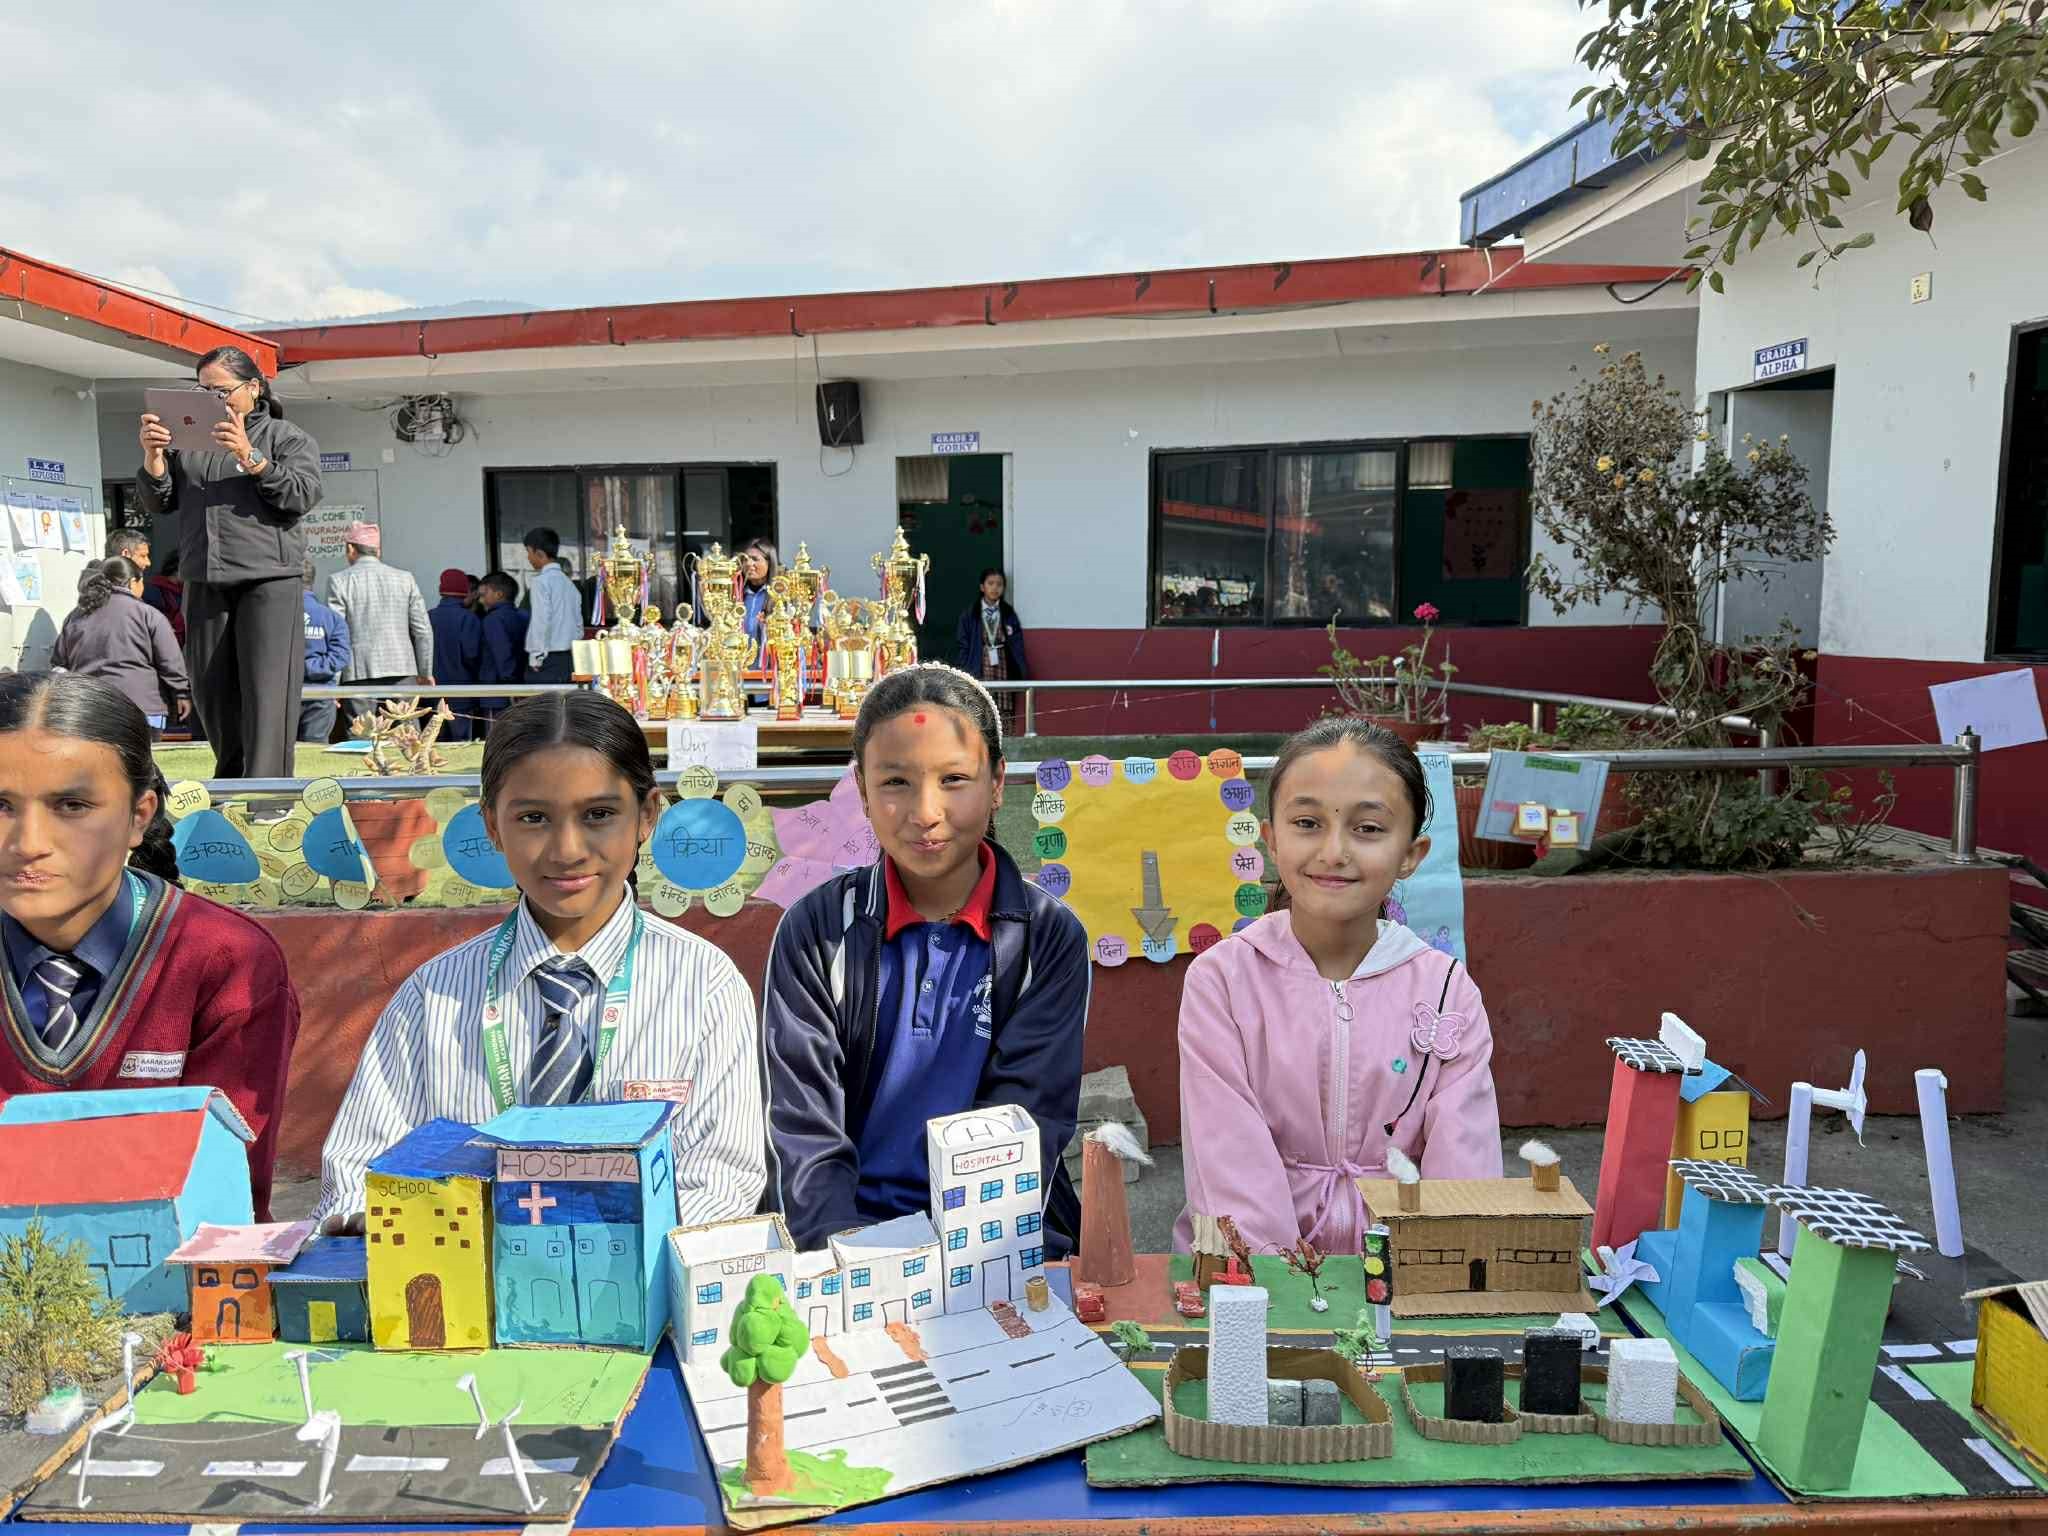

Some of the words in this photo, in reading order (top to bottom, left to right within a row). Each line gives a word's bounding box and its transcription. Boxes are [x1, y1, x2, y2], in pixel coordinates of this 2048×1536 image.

[1760, 345, 1793, 363] GRADE
[1761, 359, 1797, 377] ALPHA
[966, 1123, 992, 1142] H
[501, 1153, 637, 1178] HOSPITAL
[955, 1154, 1003, 1171] HOSPITAL
[378, 1181, 437, 1197] SCHOOL
[727, 1255, 762, 1273] SHOP
